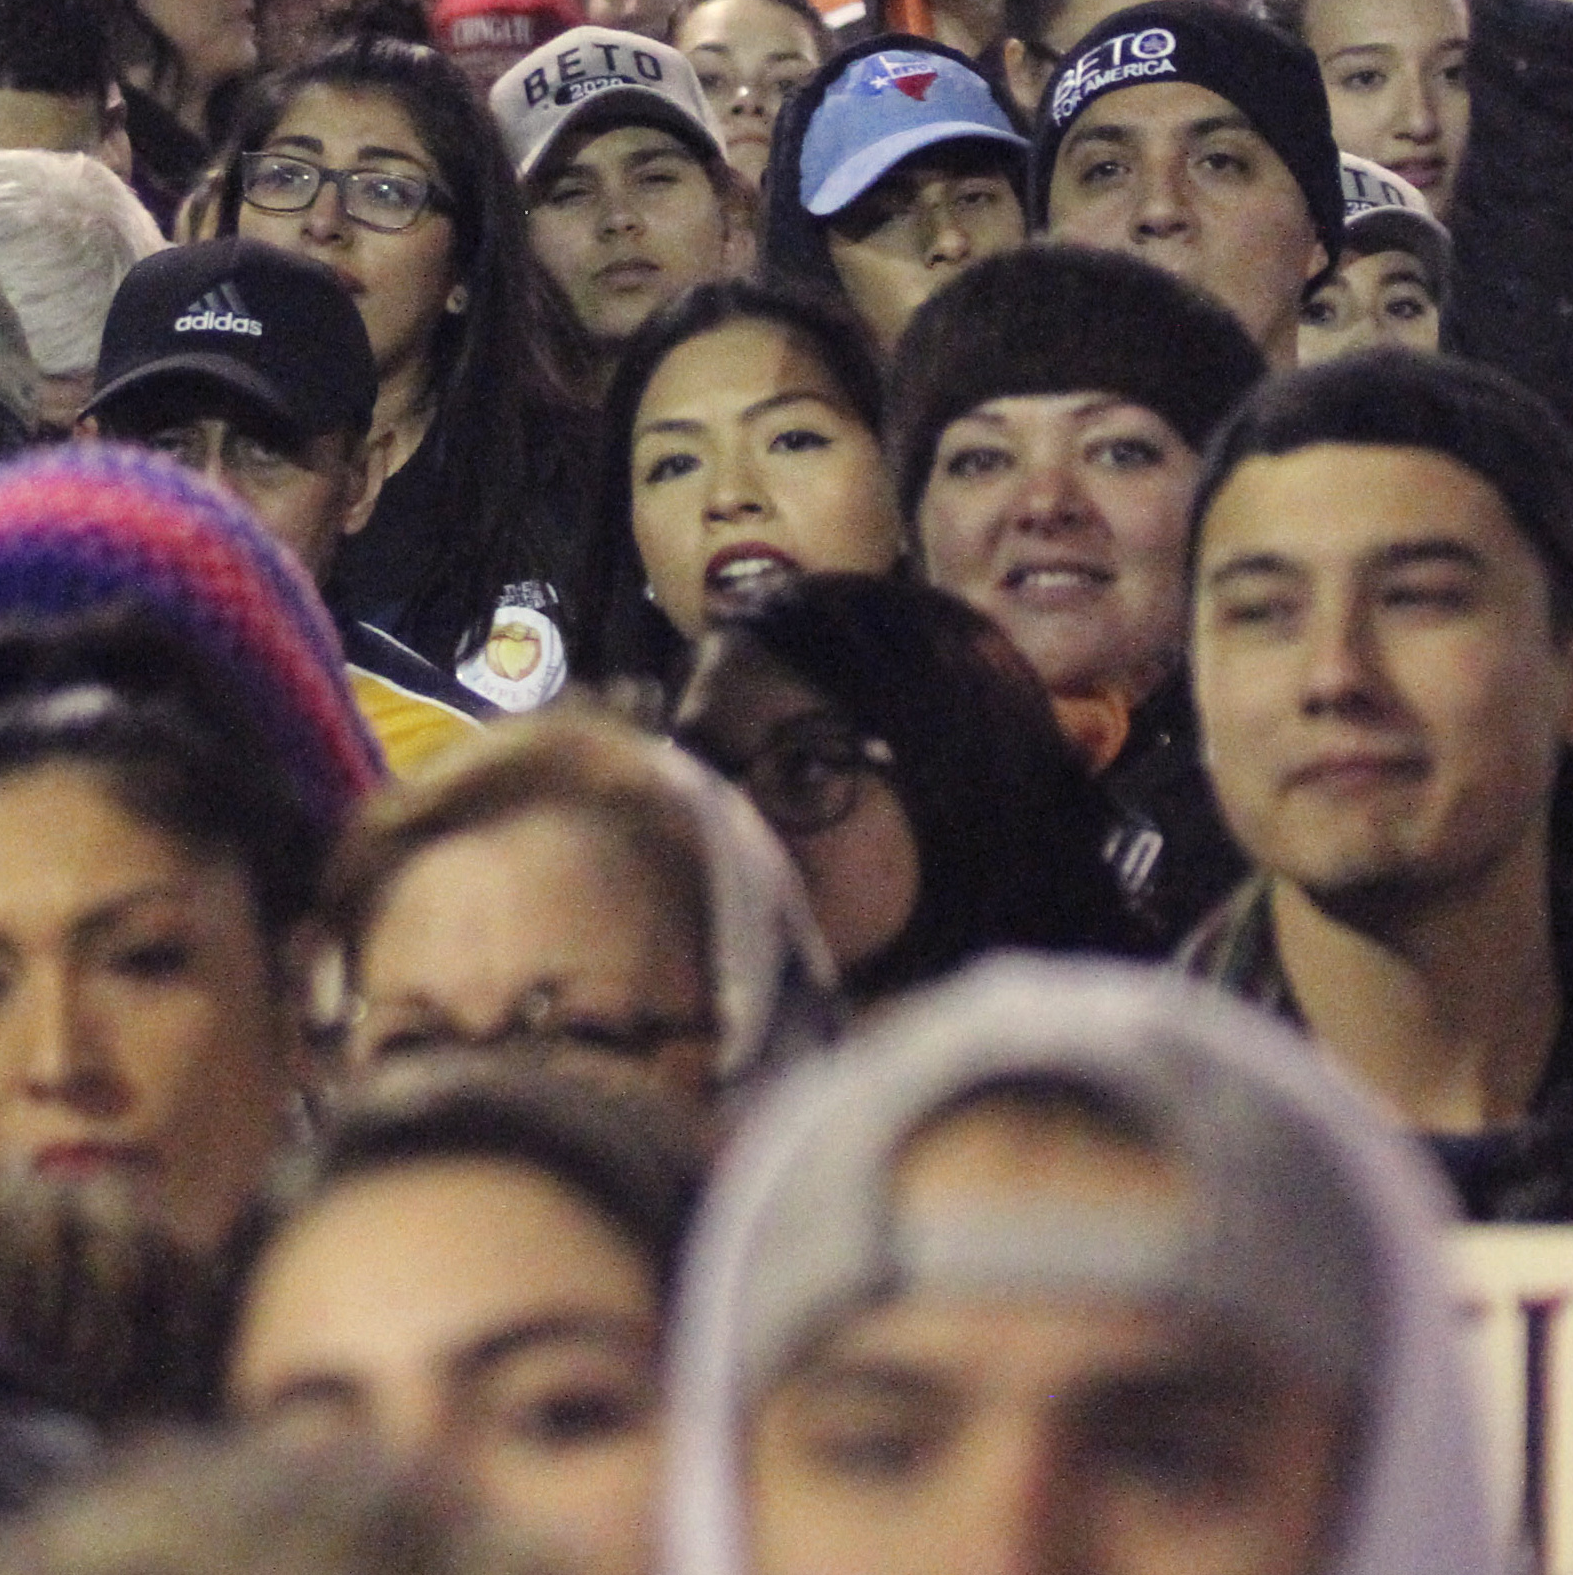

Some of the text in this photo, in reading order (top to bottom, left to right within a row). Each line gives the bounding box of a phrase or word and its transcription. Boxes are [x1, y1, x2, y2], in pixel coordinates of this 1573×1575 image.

[523, 42, 663, 107] BETO
[1052, 28, 1177, 109] BETO
[1084, 58, 1177, 96] AMERICA
[174, 310, 263, 336] adidas
